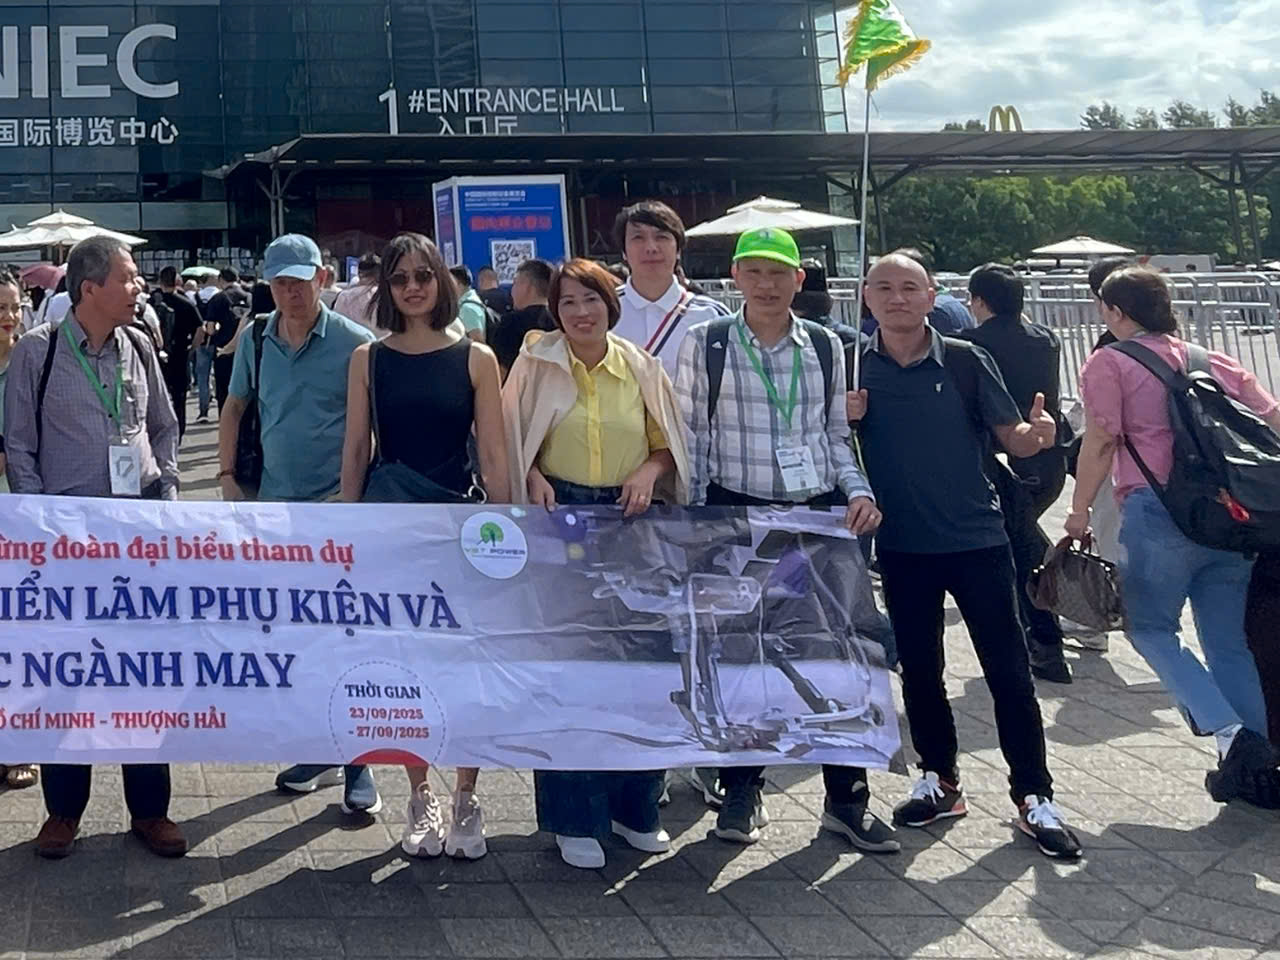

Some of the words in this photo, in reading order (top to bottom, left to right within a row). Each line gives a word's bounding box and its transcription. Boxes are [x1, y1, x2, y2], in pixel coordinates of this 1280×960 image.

[378, 88, 399, 135] 1
[407, 87, 558, 114] #ENTRANCE
[564, 87, 625, 113] HALL
[52, 533, 120, 561] đoàn
[126, 535, 169, 568] đại
[175, 530, 234, 561] biểu
[241, 538, 314, 563] tham
[319, 539, 355, 572] dự
[84, 576, 178, 621] LÃM
[189, 585, 278, 634] PHỤ
[288, 578, 392, 637] KIỆN
[398, 581, 462, 629] VÀ
[22, 638, 183, 689] NGÀNH
[193, 651, 296, 689] MAY
[344, 679, 381, 699] THỜI
[384, 685, 421, 700] GIAN
[10, 706, 41, 730] CHÍ
[44, 711, 96, 730] MINH
[111, 710, 191, 735] THƯỢNG
[194, 707, 227, 730] HẢI
[349, 706, 424, 722] 23/09/2025
[356, 725, 430, 741] 27/09/2025
